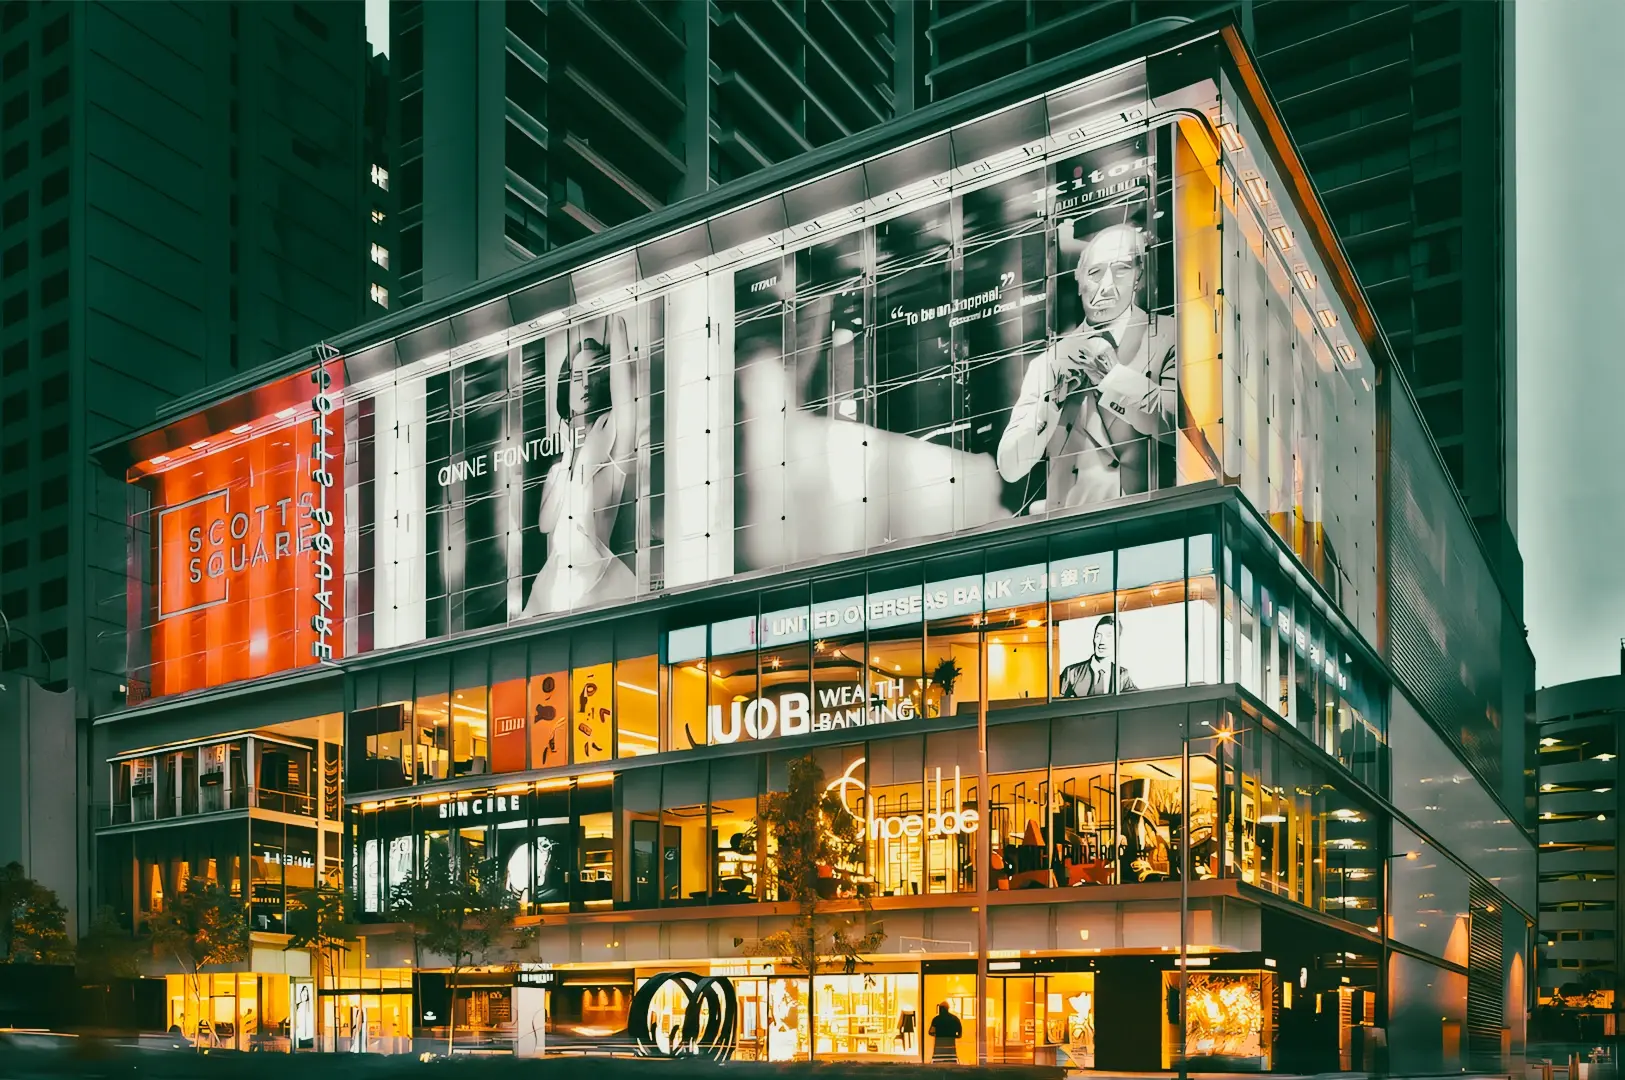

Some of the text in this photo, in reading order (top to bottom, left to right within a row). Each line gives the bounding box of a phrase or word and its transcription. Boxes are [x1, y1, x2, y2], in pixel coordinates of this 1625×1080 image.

[189, 491, 314, 552] SCOTTS
[188, 522, 314, 583] SQUARE
[772, 578, 1012, 636] UNITED OVERSEAS BANK
[709, 692, 811, 746] UOB
